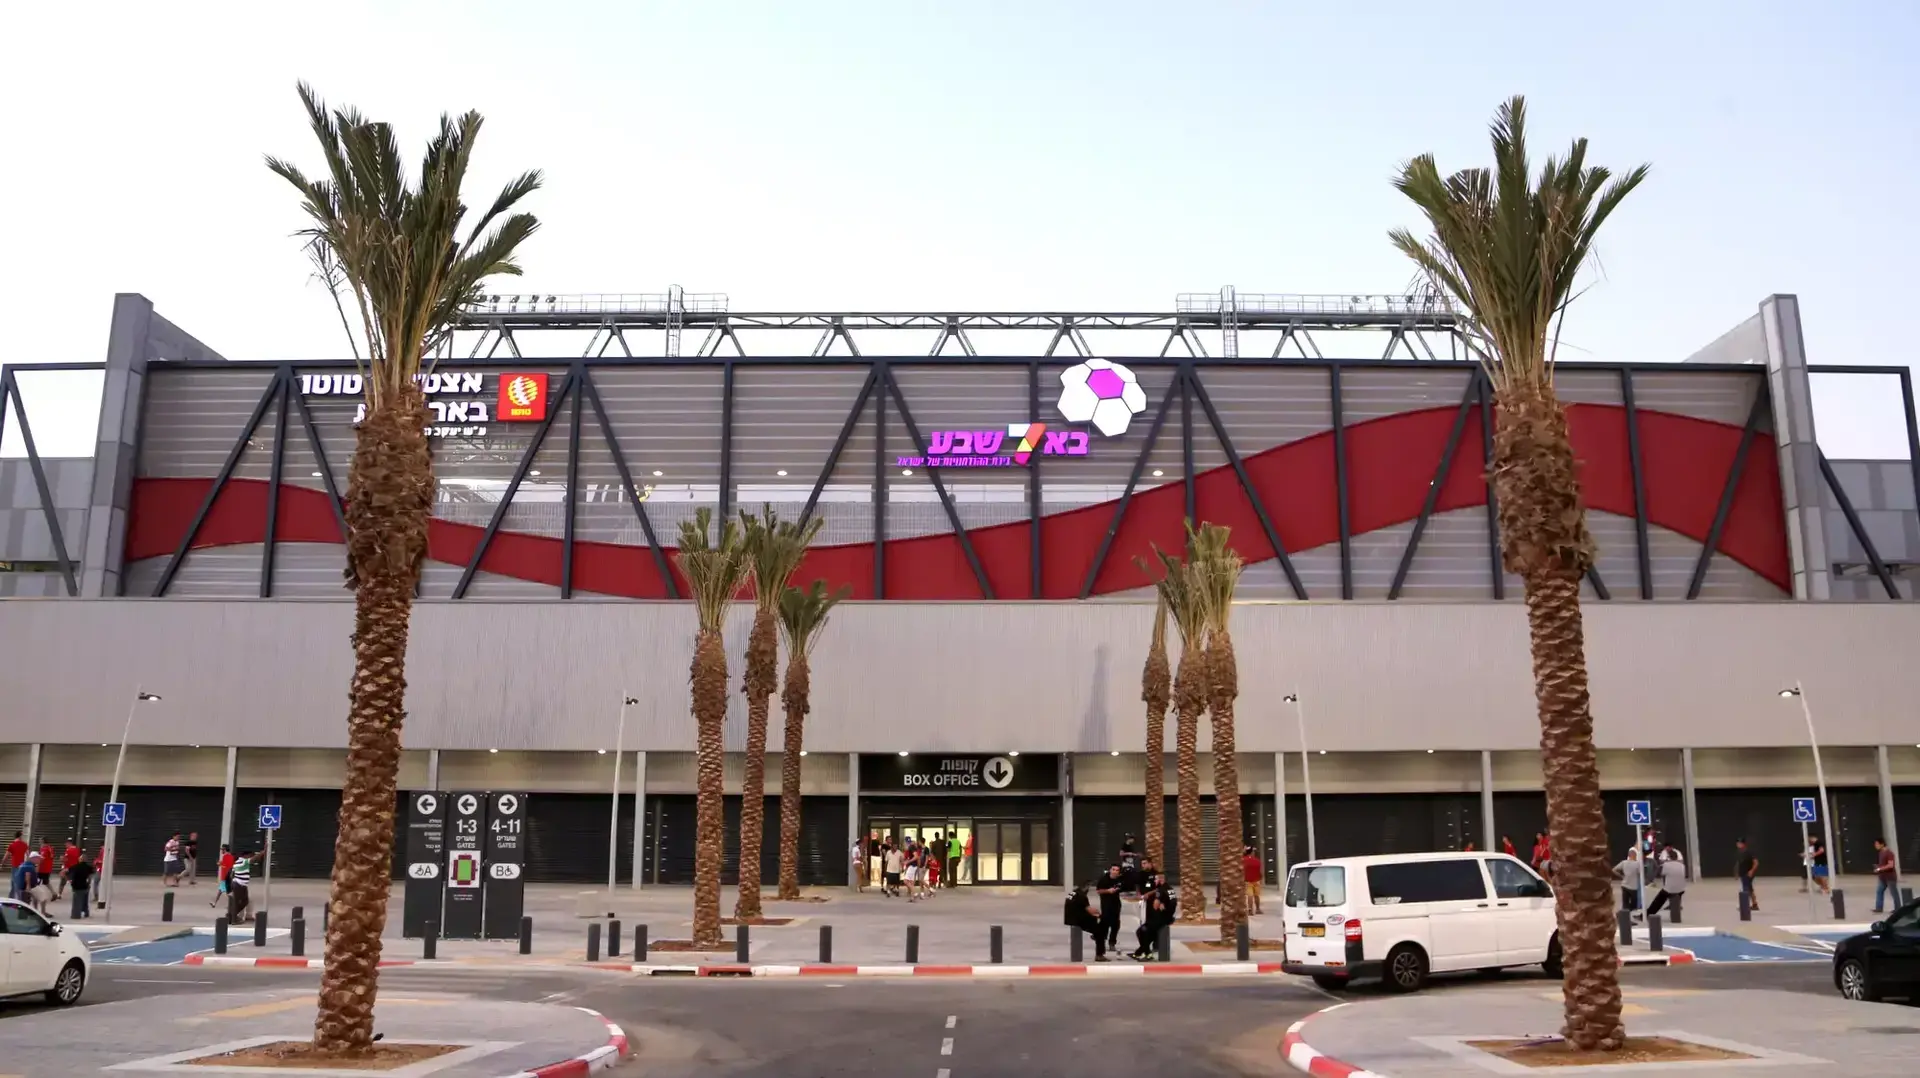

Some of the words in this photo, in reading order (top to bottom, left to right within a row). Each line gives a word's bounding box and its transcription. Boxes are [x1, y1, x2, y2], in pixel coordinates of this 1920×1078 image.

[301, 373, 363, 395] טוטו
[428, 401, 489, 423] באר
[928, 431, 1005, 456] שבע
[940, 759, 979, 774] קופות
[903, 774, 931, 786] BOX
[933, 774, 979, 786] OFFICE
[456, 819, 478, 833] 1-3
[491, 819, 521, 833] 4-11
[424, 865, 432, 876] A
[496, 865, 504, 876] B
